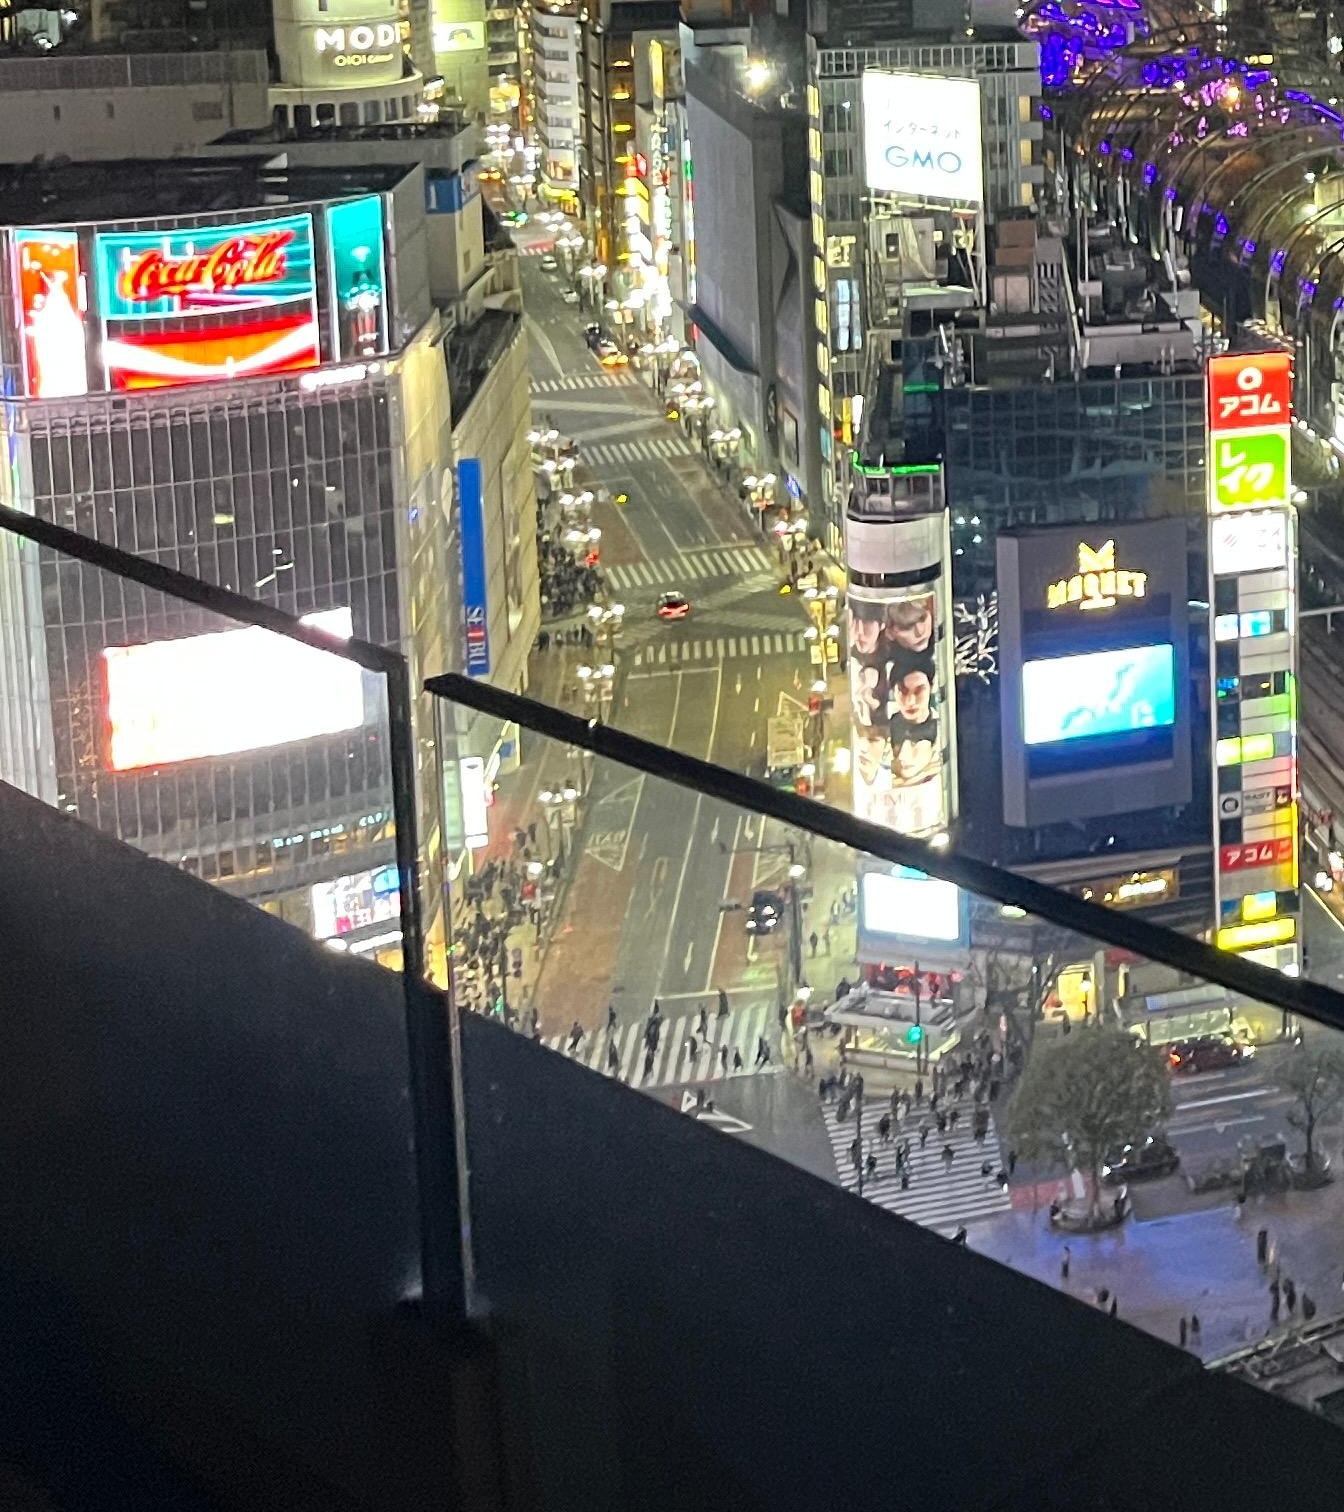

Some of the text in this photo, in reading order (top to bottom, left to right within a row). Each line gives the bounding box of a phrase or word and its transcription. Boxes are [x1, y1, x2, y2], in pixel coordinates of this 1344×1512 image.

[313, 23, 402, 53] MODI
[885, 145, 962, 173] GMO
[116, 229, 296, 303] Coca-Cola
[1219, 392, 1281, 419] アコム
[467, 607, 487, 665] SEIBU
[1227, 846, 1273, 866] アコム
